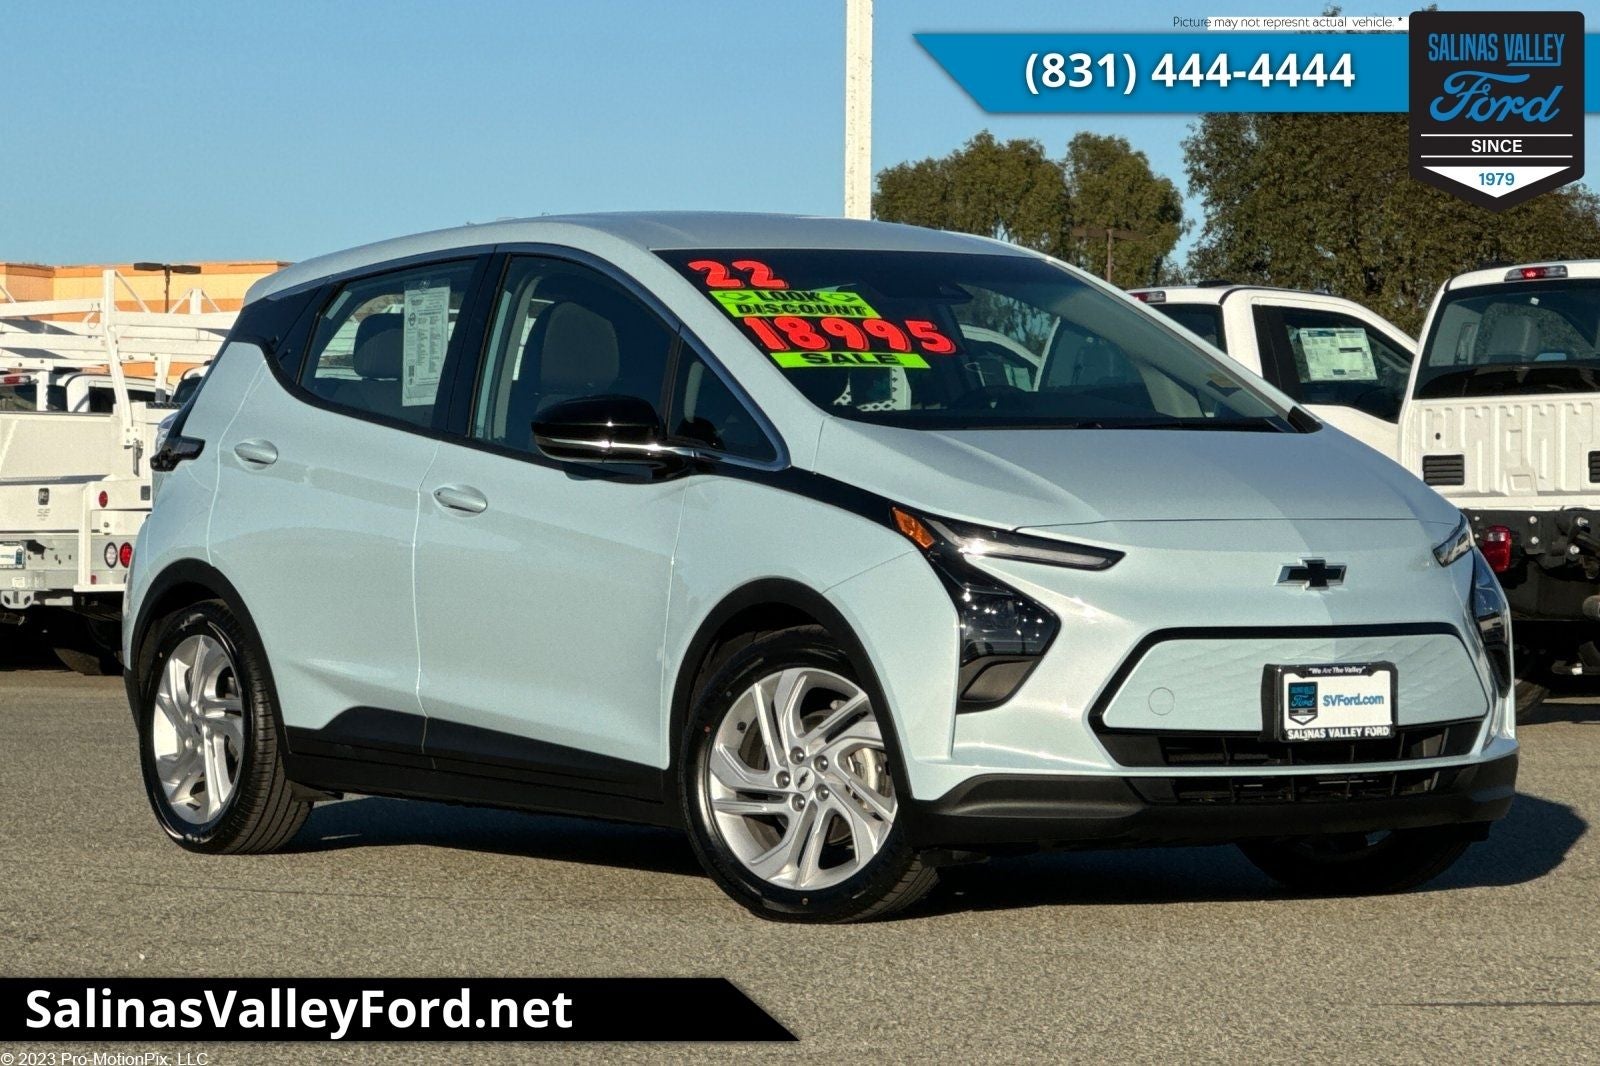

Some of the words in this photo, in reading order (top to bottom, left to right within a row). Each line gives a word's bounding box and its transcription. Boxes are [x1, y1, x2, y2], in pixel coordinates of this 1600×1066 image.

[687, 260, 790, 290] 22
[754, 290, 824, 302] LOOK
[737, 303, 867, 317] DISCOUNT
[743, 316, 957, 354] 18995
[803, 353, 901, 366] SALE
[1322, 693, 1384, 707] SVFord.com
[1287, 728, 1326, 740] SALINAS
[1327, 727, 1362, 739] VALLEY
[1364, 726, 1389, 737] FORD
